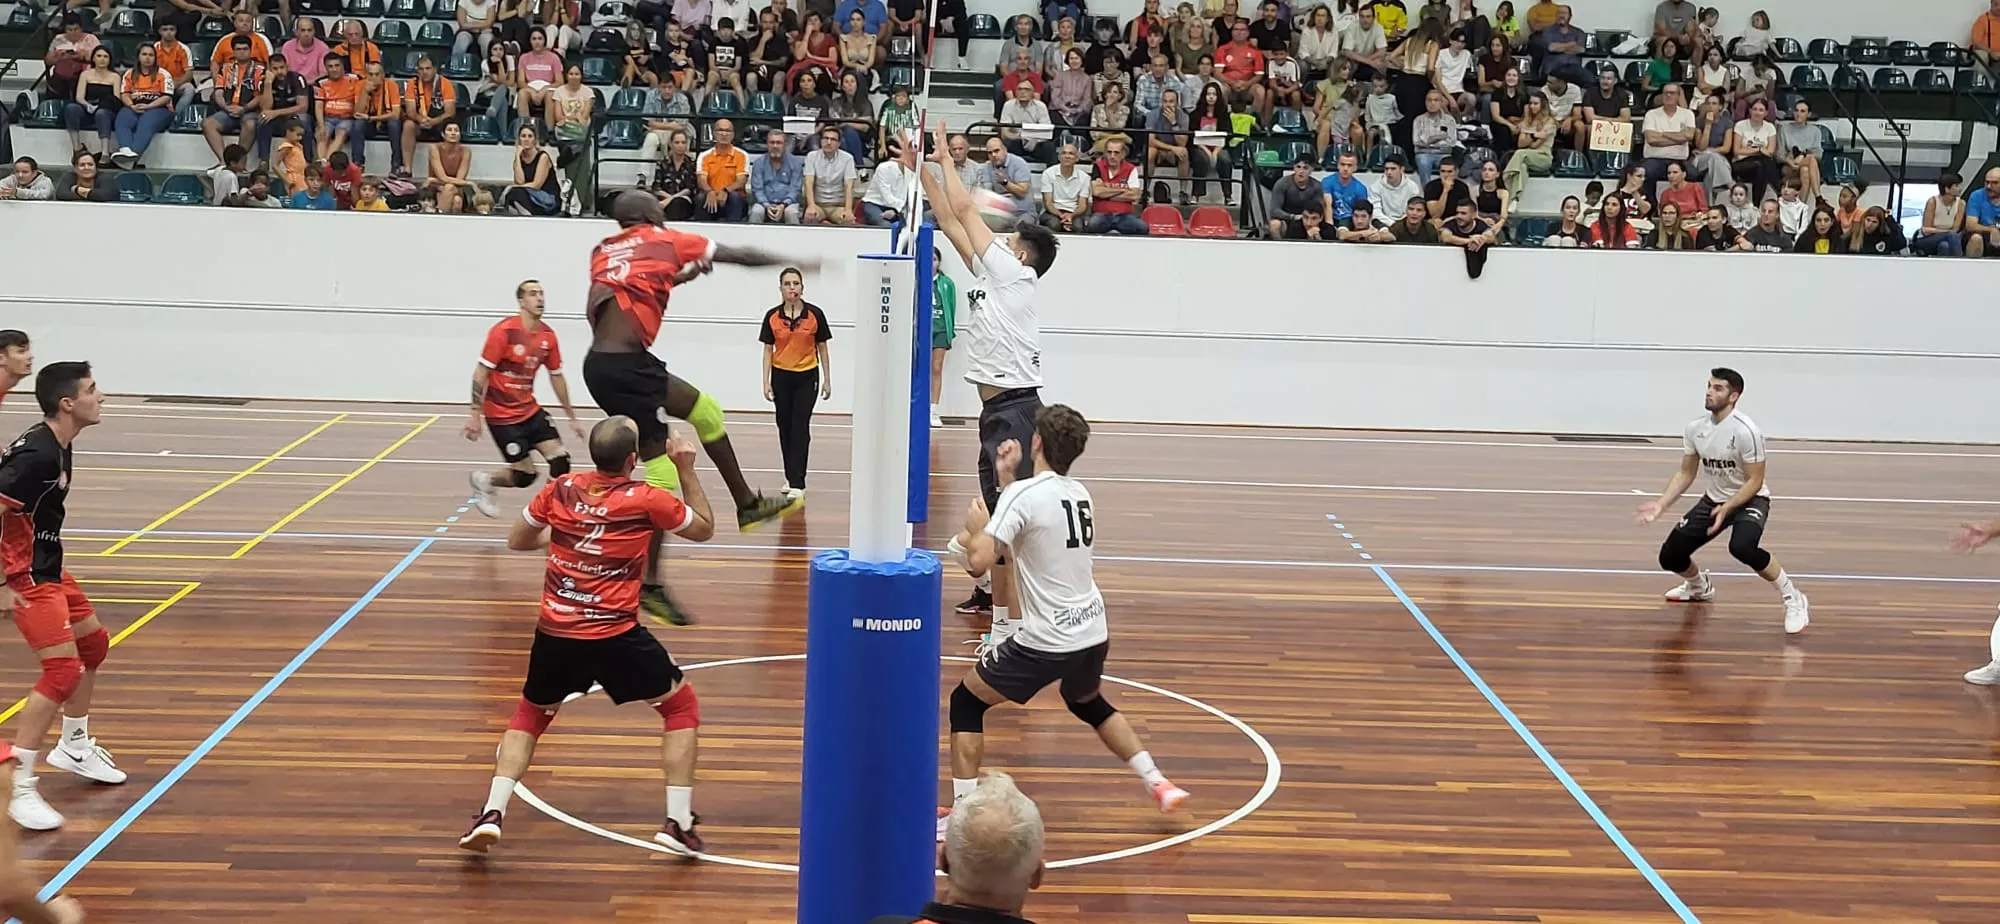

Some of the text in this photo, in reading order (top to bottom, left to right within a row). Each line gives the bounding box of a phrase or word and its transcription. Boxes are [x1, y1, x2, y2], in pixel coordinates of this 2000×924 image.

[880, 286, 891, 334] MONDO
[573, 520, 606, 556] 2
[1061, 499, 1094, 548] 16
[865, 618, 922, 632] MONDO
